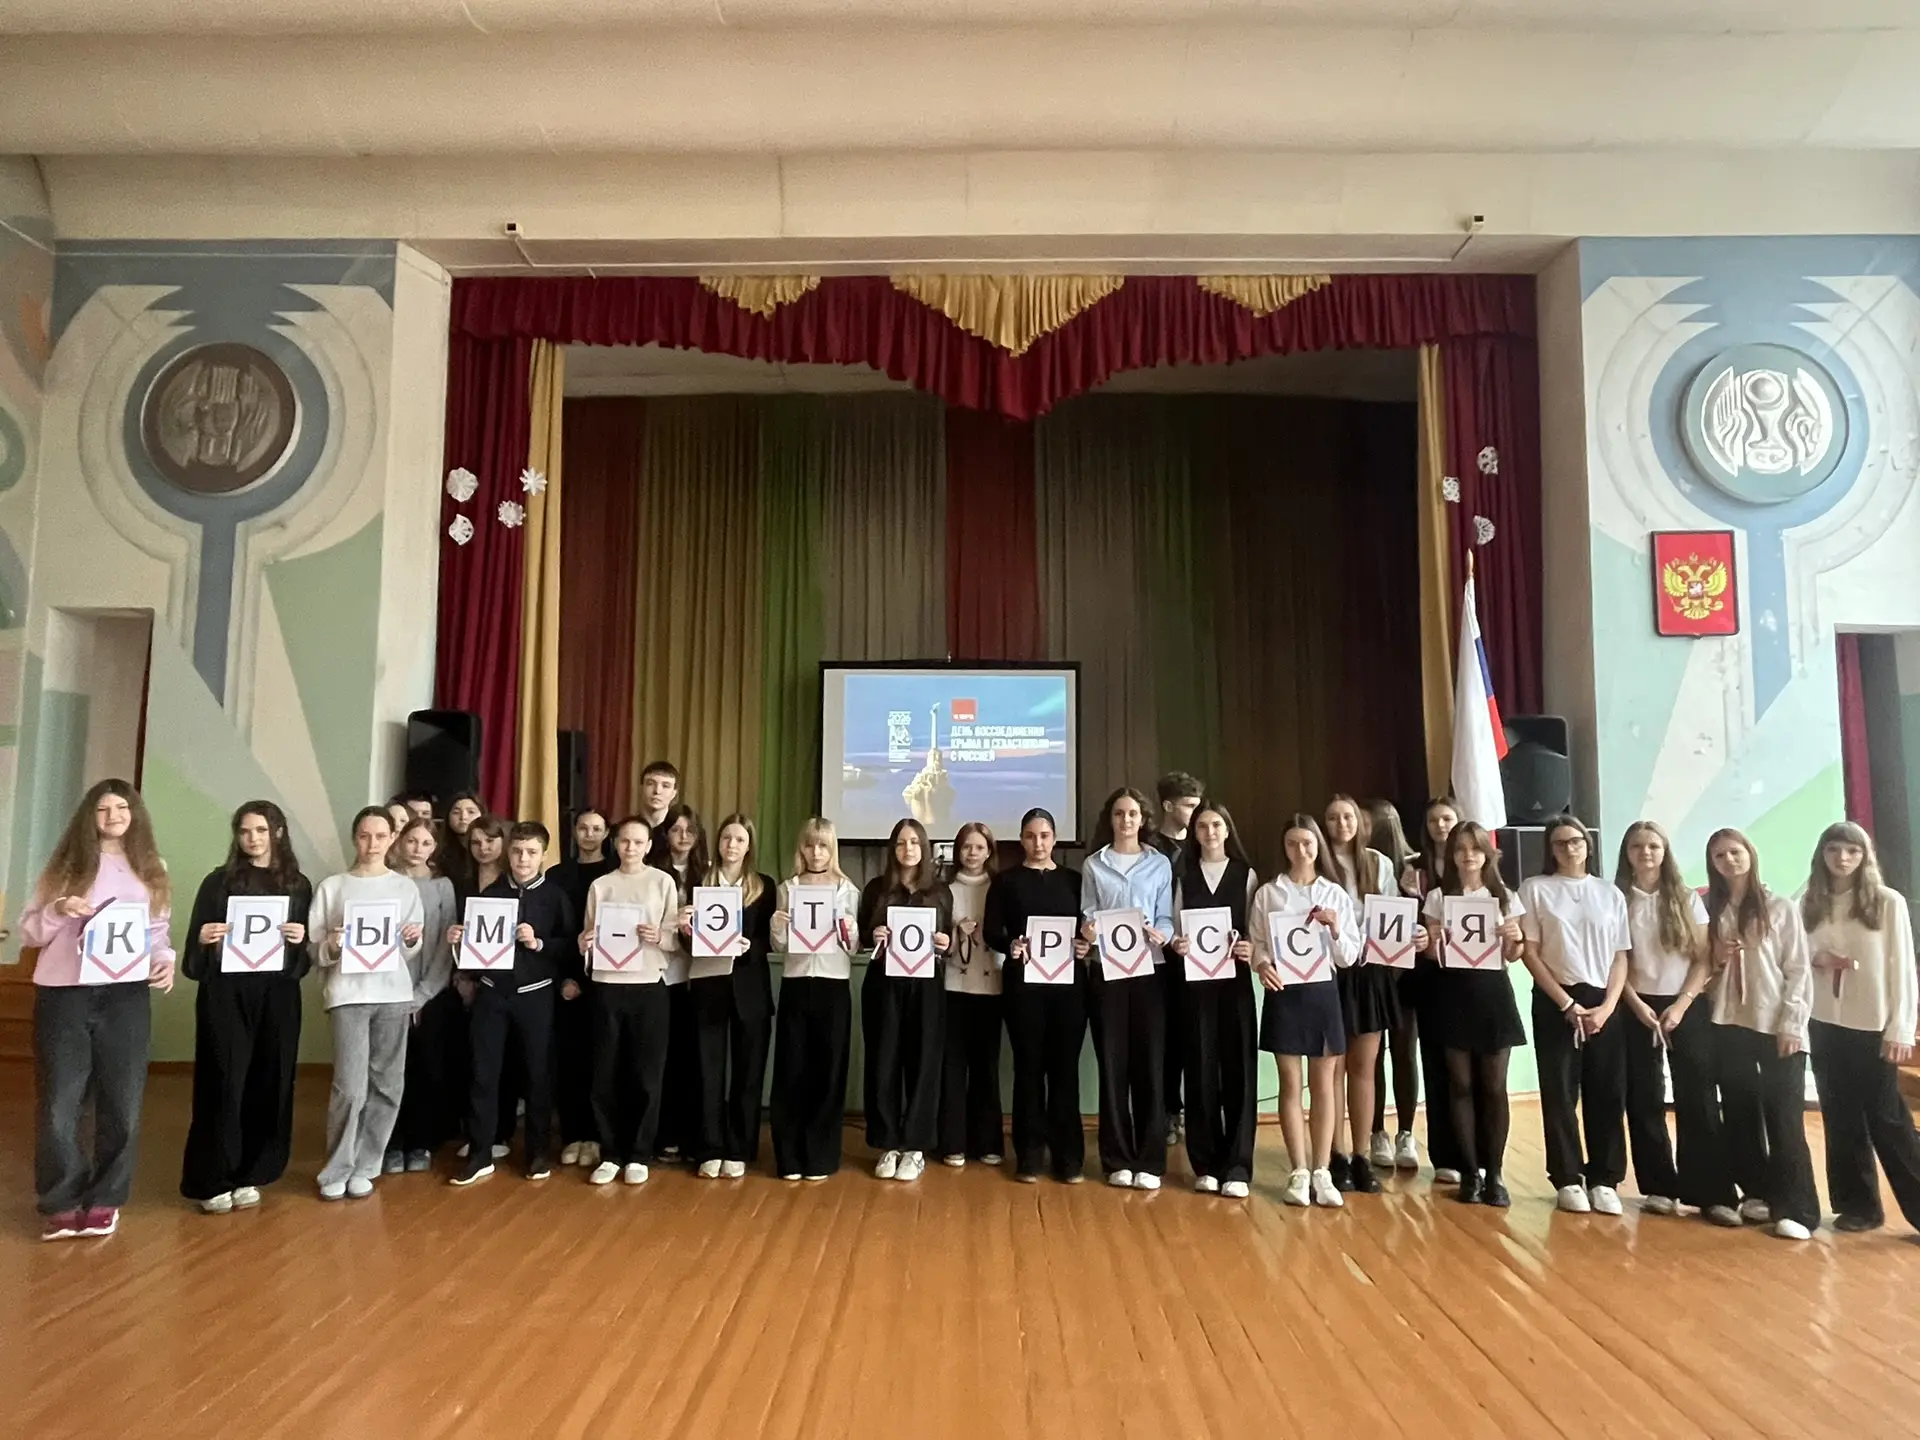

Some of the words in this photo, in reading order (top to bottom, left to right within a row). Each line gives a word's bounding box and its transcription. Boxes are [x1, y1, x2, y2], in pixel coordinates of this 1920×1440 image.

[244, 915, 270, 944] Р
[476, 915, 504, 943] М
[706, 904, 729, 931] Э
[803, 902, 824, 929] Т
[1379, 913, 1403, 942] И
[1461, 914, 1485, 943] Я
[106, 923, 133, 954] К
[357, 917, 389, 945] Ы
[900, 924, 924, 951] О
[1040, 931, 1062, 957] Р
[1112, 924, 1136, 951] О
[1197, 926, 1220, 953] С
[1287, 928, 1312, 956] С
